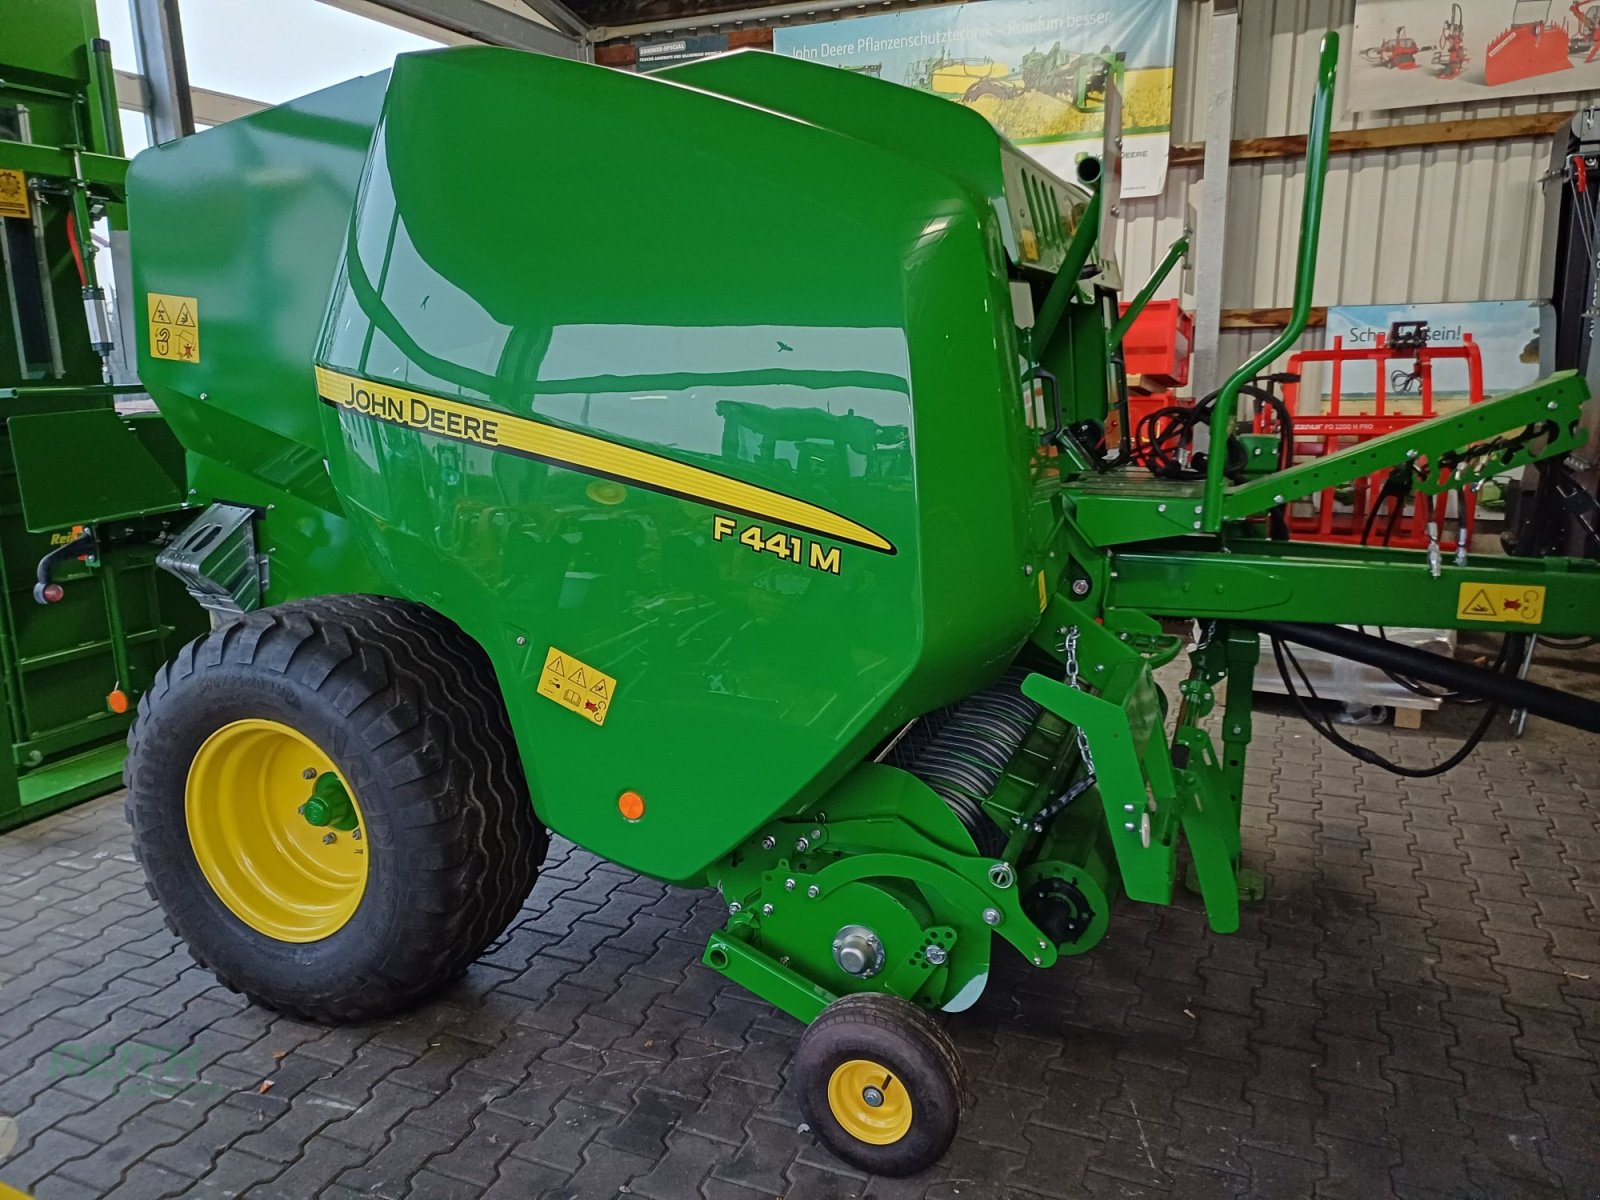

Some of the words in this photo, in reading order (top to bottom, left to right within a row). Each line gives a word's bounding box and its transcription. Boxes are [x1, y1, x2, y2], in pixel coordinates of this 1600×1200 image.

[792, 46, 818, 59] John
[821, 43, 854, 58] Deere
[858, 25, 993, 53] Pflanzenschutztechnik
[1008, 16, 1063, 35] Rundum
[1067, 11, 1113, 28] besser.
[345, 383, 404, 421] JOHN
[410, 398, 499, 443] DEERE
[713, 514, 737, 543] F
[740, 524, 803, 565] 441
[809, 541, 842, 576] M
